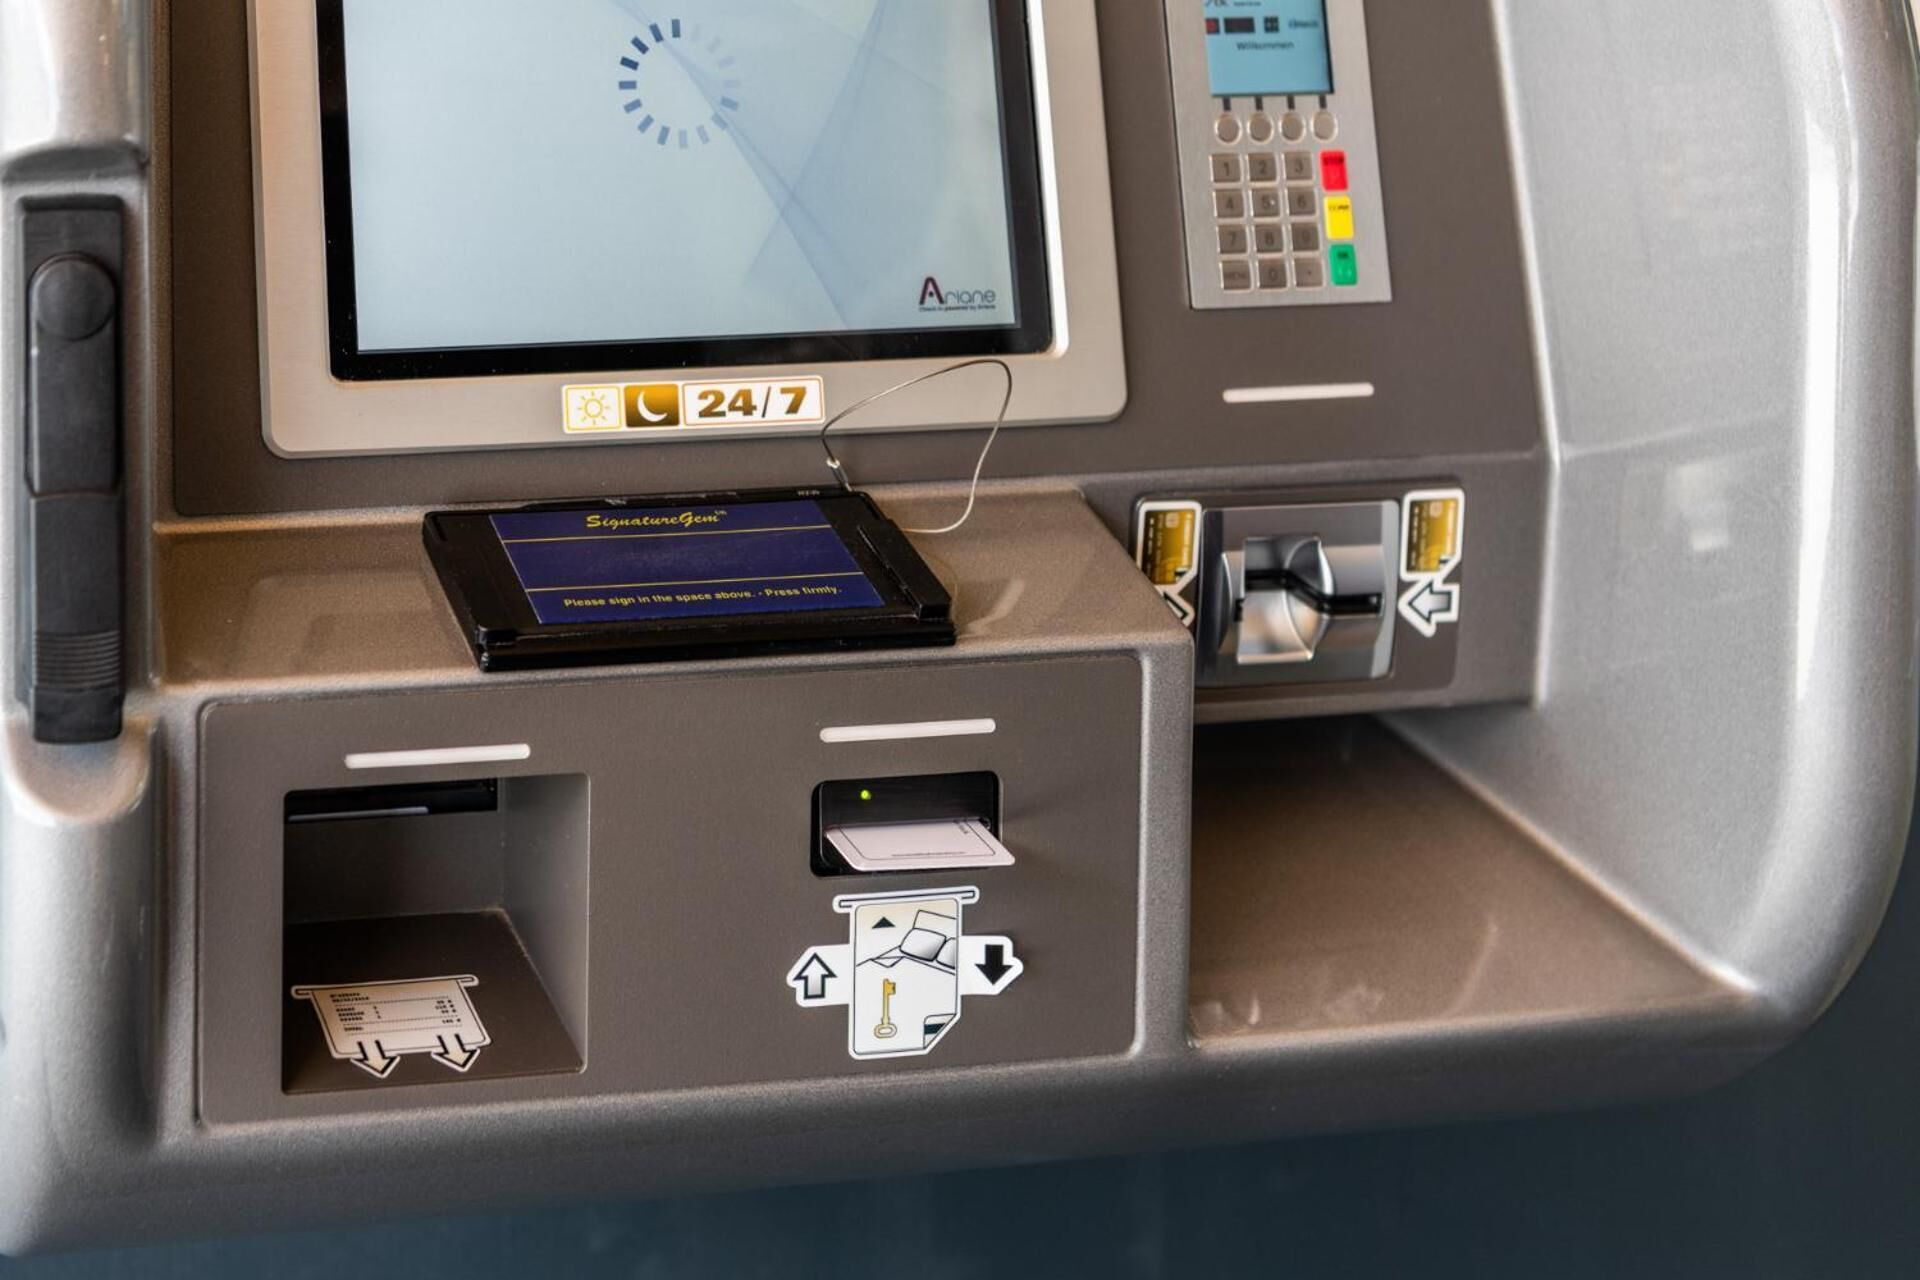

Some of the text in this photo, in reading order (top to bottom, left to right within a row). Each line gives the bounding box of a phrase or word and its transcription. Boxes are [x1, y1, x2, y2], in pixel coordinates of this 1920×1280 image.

[1223, 162, 1230, 176] 1
[1258, 160, 1268, 175] 2
[1228, 231, 1237, 246] 7
[1264, 231, 1275, 246] 8
[919, 277, 996, 305] Ariane
[698, 387, 807, 418] 24/7
[564, 598, 605, 607] Please
[609, 595, 635, 606] sign
[638, 595, 651, 603] in
[652, 594, 673, 602] the
[676, 591, 712, 602] space
[715, 590, 756, 599] above.
[764, 588, 800, 597] Press
[802, 585, 842, 595] firmly.
